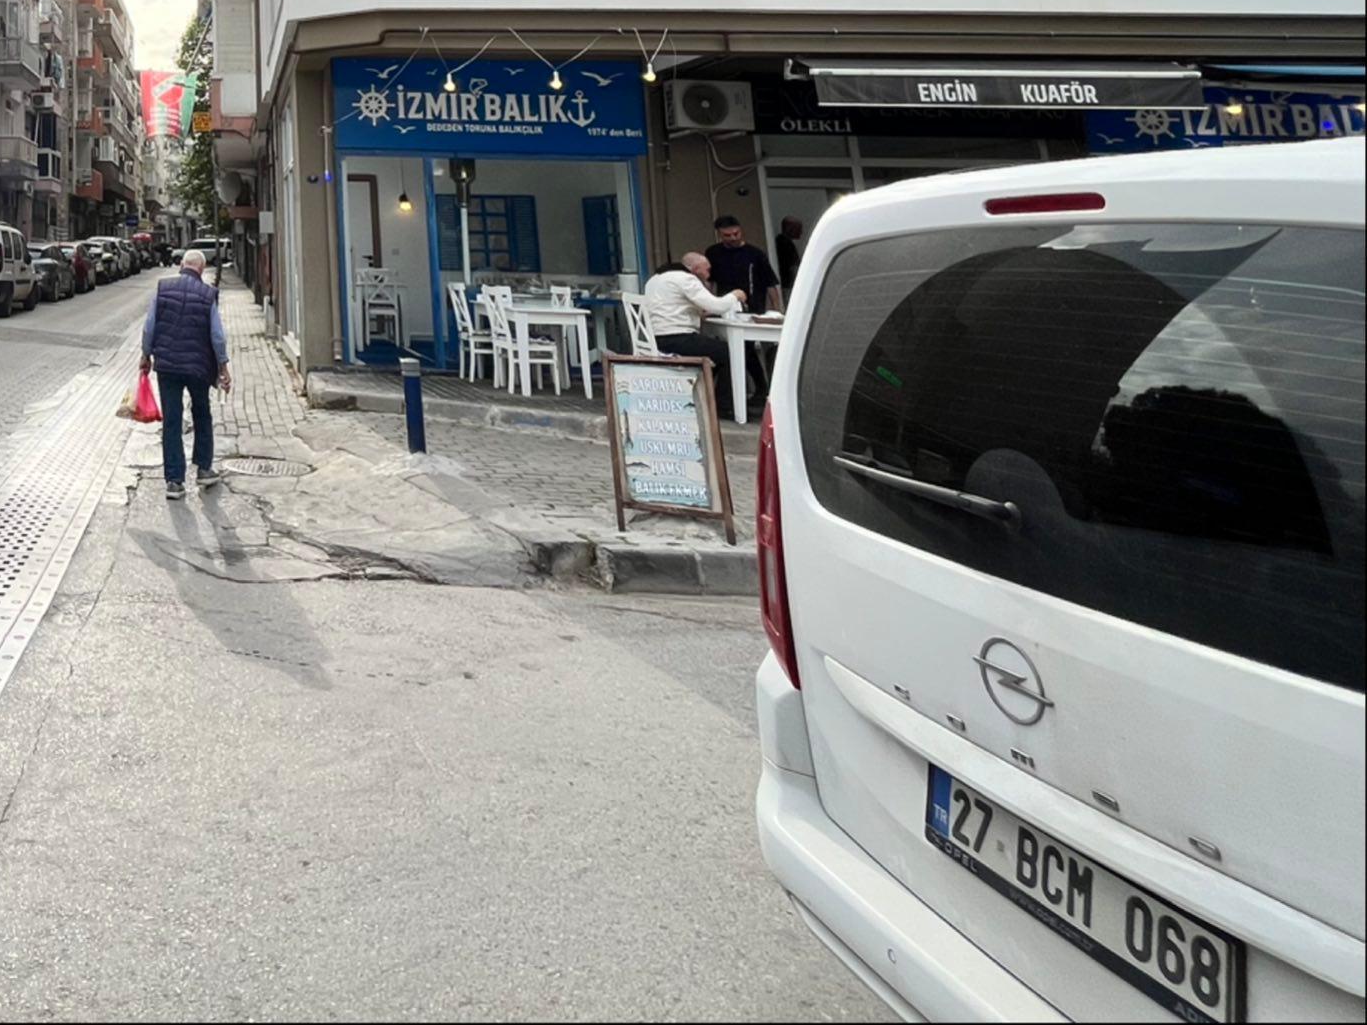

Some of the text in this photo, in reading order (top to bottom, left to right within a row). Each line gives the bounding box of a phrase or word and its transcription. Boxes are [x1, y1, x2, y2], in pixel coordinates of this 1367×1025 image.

[917, 79, 1099, 104] ENGİN KUAFÖR
[484, 92, 571, 123] BALIK
[426, 123, 543, 135] DEDEDEN TORUNA BALIKÇILIK
[609, 128, 624, 137] den
[625, 128, 643, 137] Beri
[639, 417, 689, 434] KALAMAR
[640, 438, 691, 456] USKUMRU
[635, 480, 708, 500] BALIK EKMEK
[943, 843, 979, 872] OPEL
[933, 803, 948, 825] TR
[951, 788, 993, 853] 27
[1016, 825, 1093, 928] BCM
[1125, 895, 1221, 1008] 068
